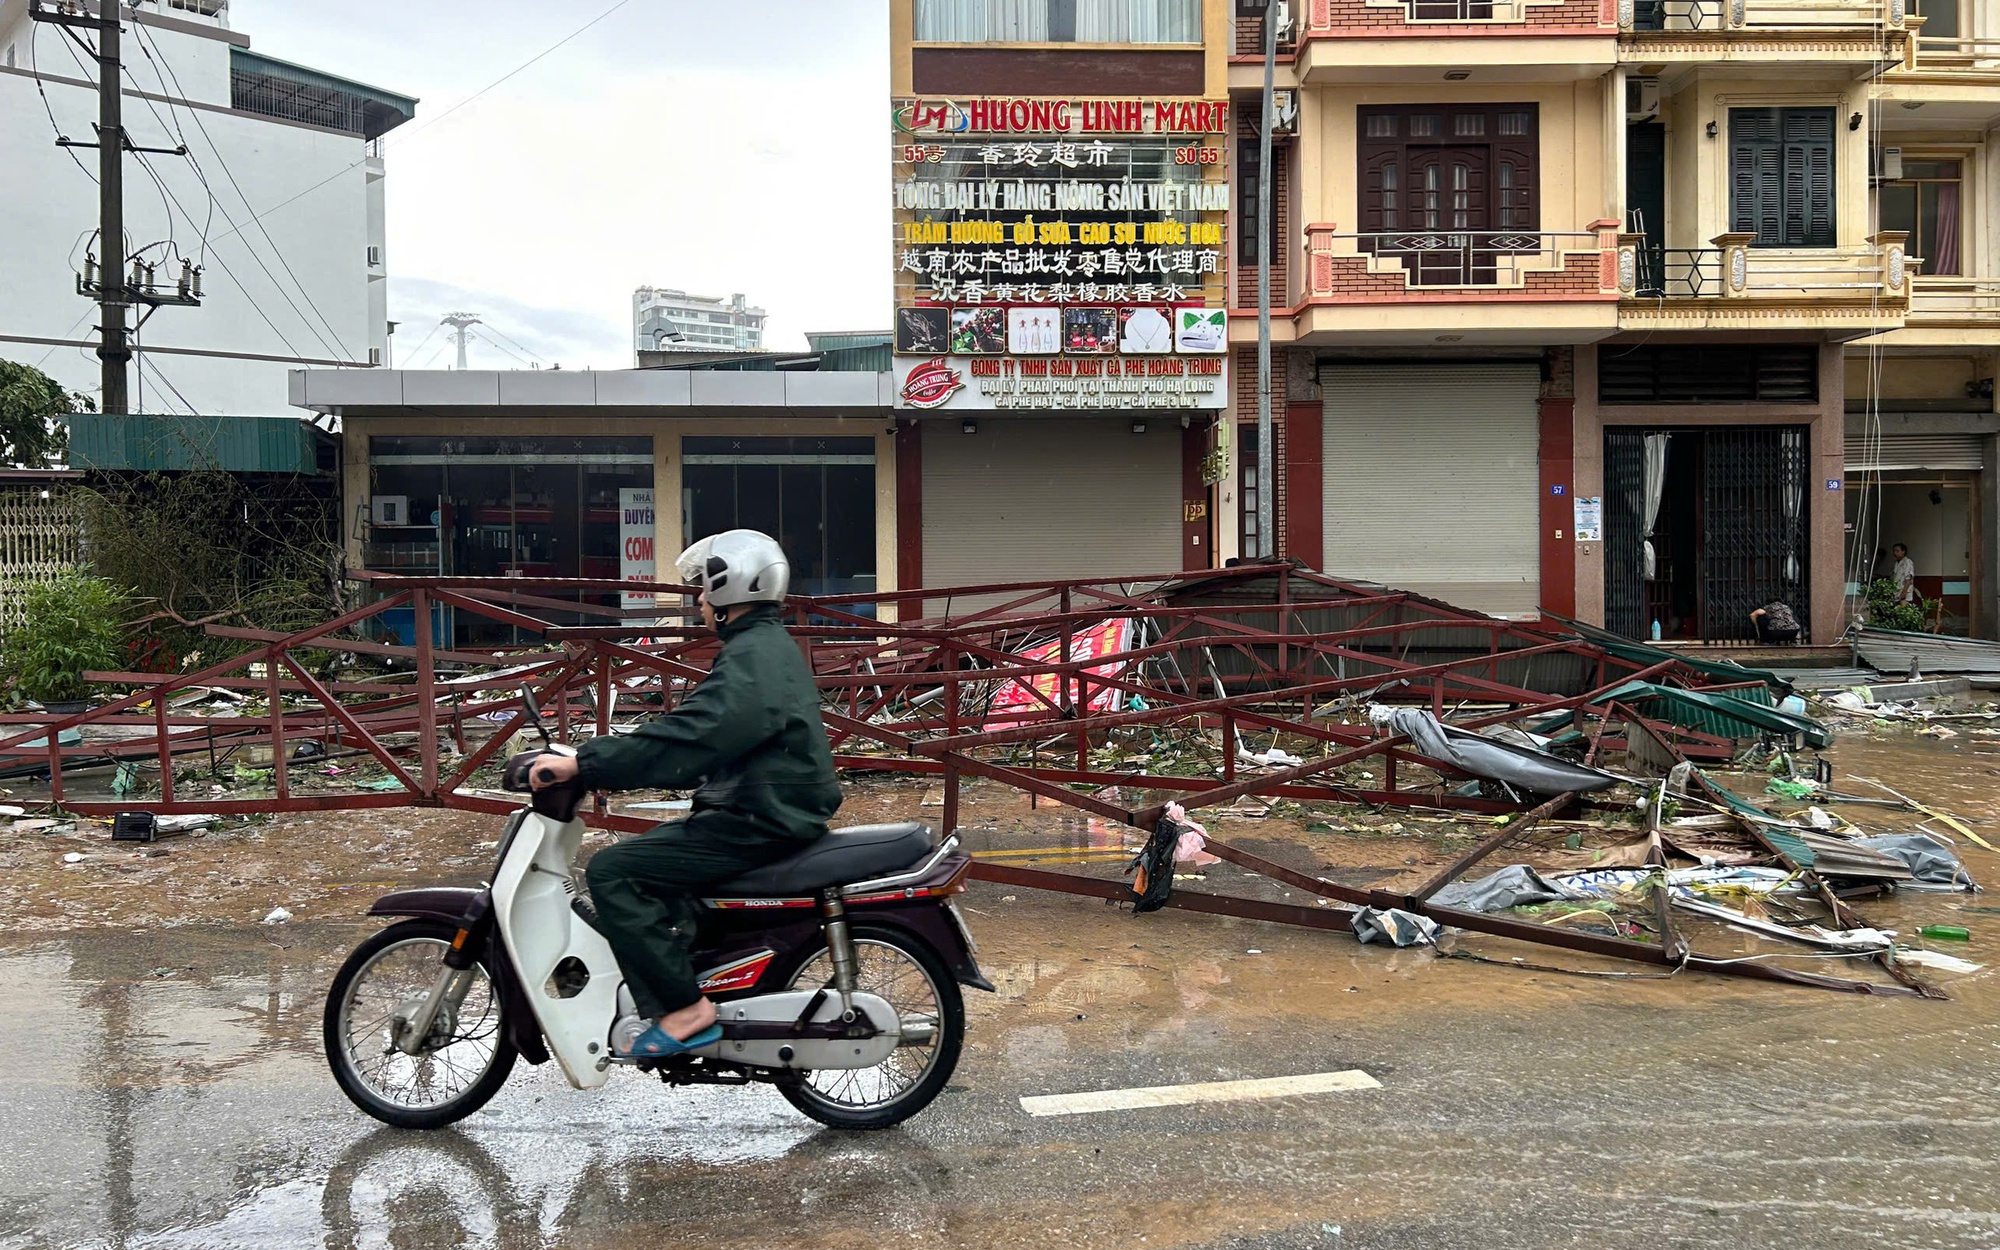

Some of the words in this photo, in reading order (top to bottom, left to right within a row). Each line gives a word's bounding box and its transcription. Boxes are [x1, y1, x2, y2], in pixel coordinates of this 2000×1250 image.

[970, 97, 1072, 133] HƯƠNG
[1081, 100, 1144, 133] LINH
[1153, 100, 1230, 133] MART
[977, 139, 1114, 168] 香玲超市
[1175, 141, 1197, 164] SỐ
[1199, 147, 1218, 164] 55
[895, 174, 940, 210] TỔNG
[944, 182, 976, 214] ĐẠI
[978, 178, 999, 210] LÝ
[1003, 178, 1051, 210] HÀNG
[1055, 178, 1103, 210] NÔNG
[1107, 175, 1144, 210] SẢN
[1147, 178, 1184, 215] VIỆT
[1188, 184, 1229, 210] NAM
[951, 219, 1004, 244] HƯƠNG
[1013, 214, 1035, 245] GỖ
[1079, 222, 1111, 245] CAO
[1114, 222, 1137, 245] SU
[1143, 218, 1186, 245] NƯỚC
[1190, 222, 1221, 245] HOA
[900, 247, 1220, 277] 越南农产品批发零售总代理商
[931, 271, 1187, 304] 沉香黄花梨橡胶香水
[971, 357, 1001, 376] CÔNG
[1002, 359, 1017, 376] TY
[1020, 359, 1048, 376] TNHH
[1050, 355, 1073, 376] SẢN
[1076, 356, 1104, 376] XUẤT
[1187, 358, 1222, 376] TRUNG
[1082, 380, 1100, 395] TẠI
[1102, 378, 1139, 394] THÀNH
[1141, 375, 1165, 394] PHỐ
[1166, 380, 1182, 396] HẠ
[1185, 380, 1214, 394] LONG
[1170, 396, 1177, 407] 3
[1179, 396, 1191, 407] IN
[1193, 396, 1199, 407] 1
[633, 491, 651, 502] NHÀ
[1553, 486, 1563, 494] 57
[1828, 481, 1838, 489] 59
